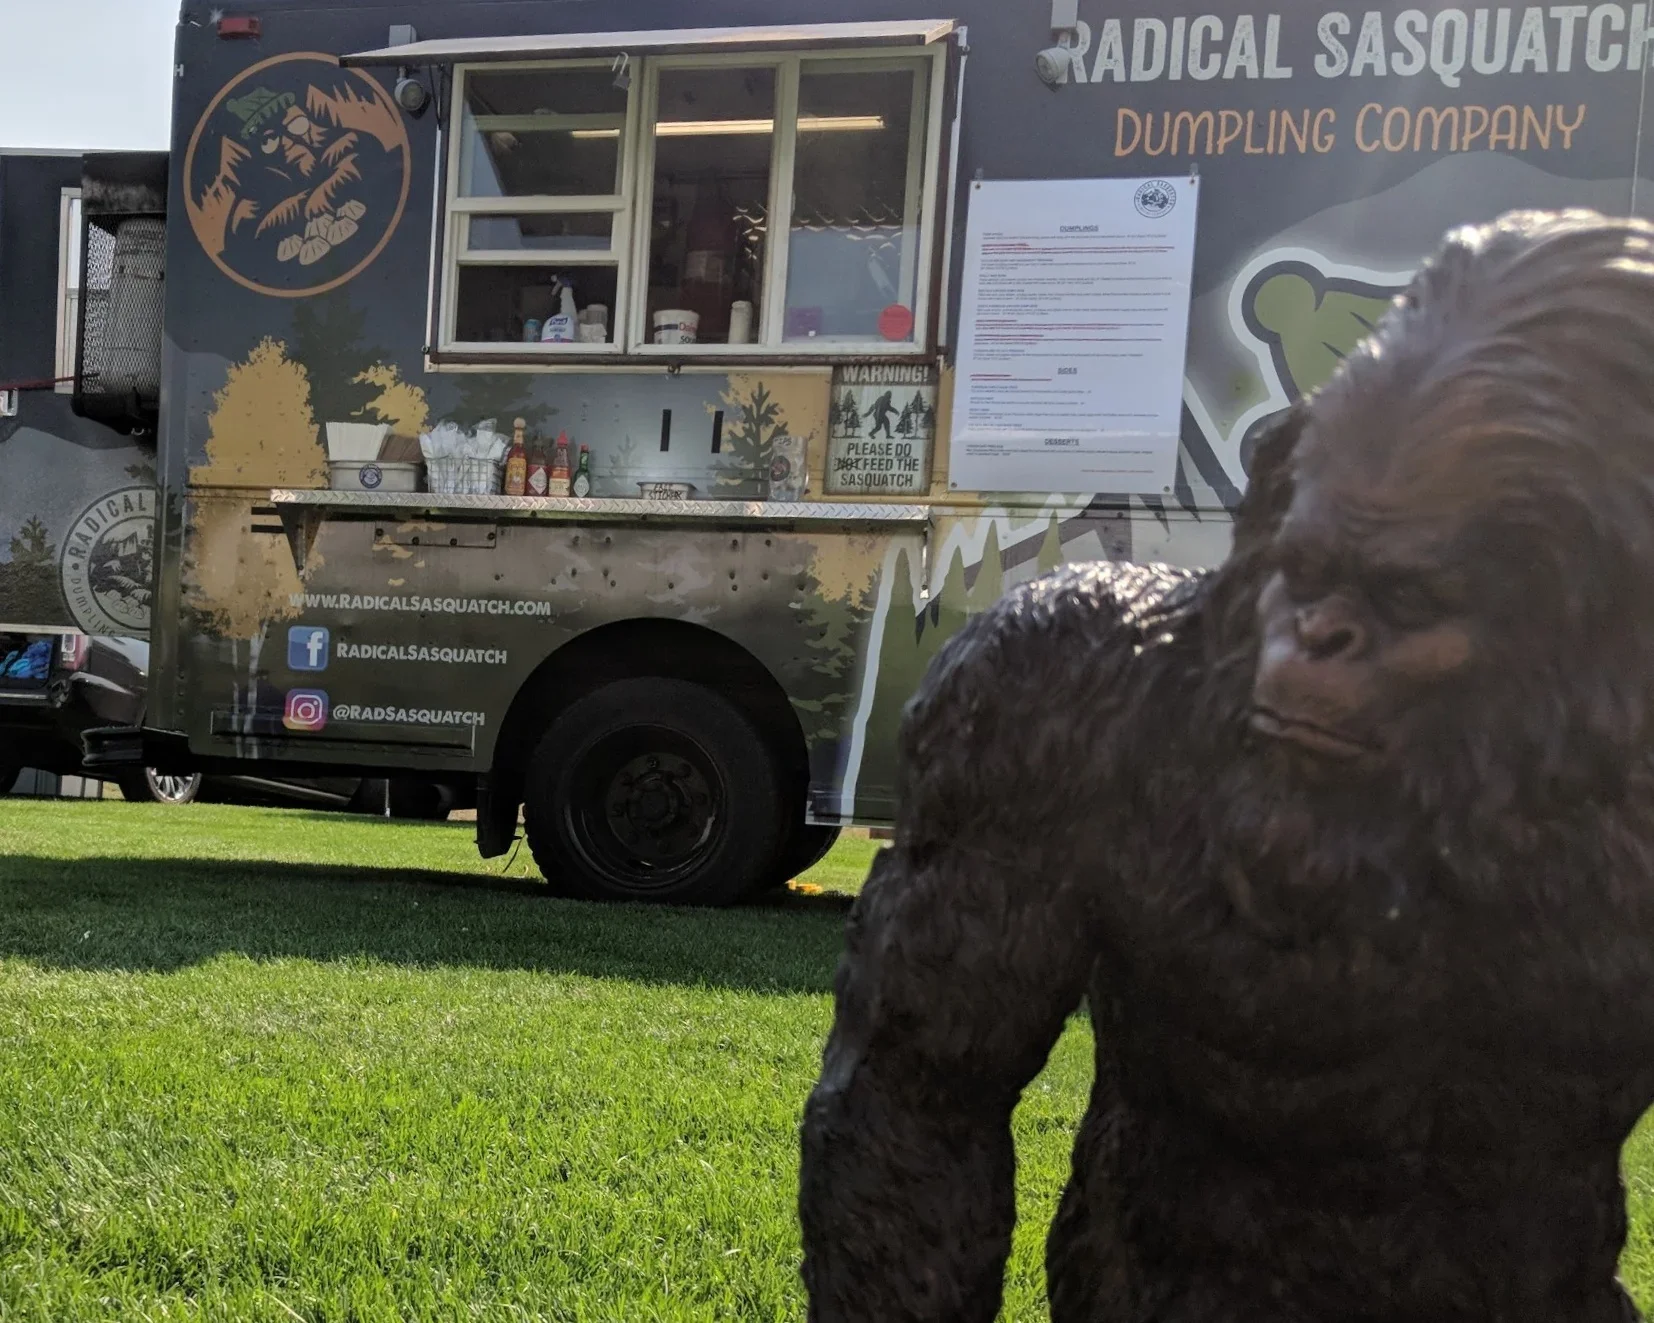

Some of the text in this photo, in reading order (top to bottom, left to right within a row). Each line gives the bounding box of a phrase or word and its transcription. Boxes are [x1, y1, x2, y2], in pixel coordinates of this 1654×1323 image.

[1055, 2, 1654, 88] RADICAL SASQUATCH
[1114, 101, 1587, 157] DUMPLING COMPANY
[1059, 224, 1099, 233] DUMPLINGS
[842, 364, 929, 383] WARNING!
[1057, 367, 1078, 375] SIDES
[847, 442, 912, 456] PLEASE DO
[1044, 438, 1080, 447] DESSERTS
[863, 458, 894, 471] FEED
[896, 458, 920, 471] THE
[840, 473, 914, 487] SASQUATCH
[68, 492, 147, 560] RADICAL
[288, 593, 551, 616] WWW.RADICALSASQUATCH.COM
[336, 642, 508, 664] RADICALSASQUATCH
[332, 704, 486, 726] @RADSASQUATCH
